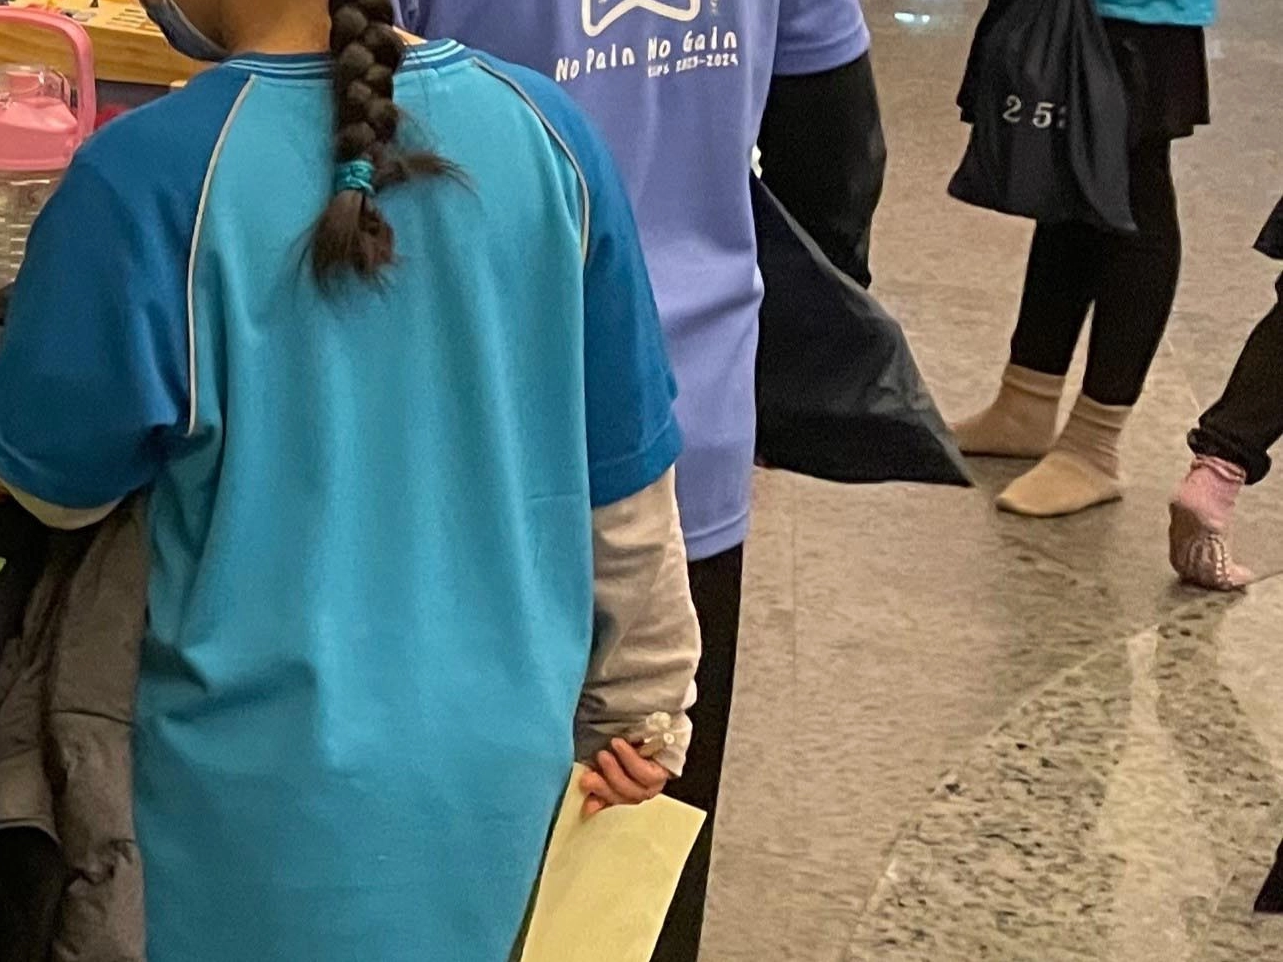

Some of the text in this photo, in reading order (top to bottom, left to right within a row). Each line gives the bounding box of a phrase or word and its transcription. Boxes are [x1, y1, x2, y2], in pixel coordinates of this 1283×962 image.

[555, 25, 738, 83] No Pain No Gain
